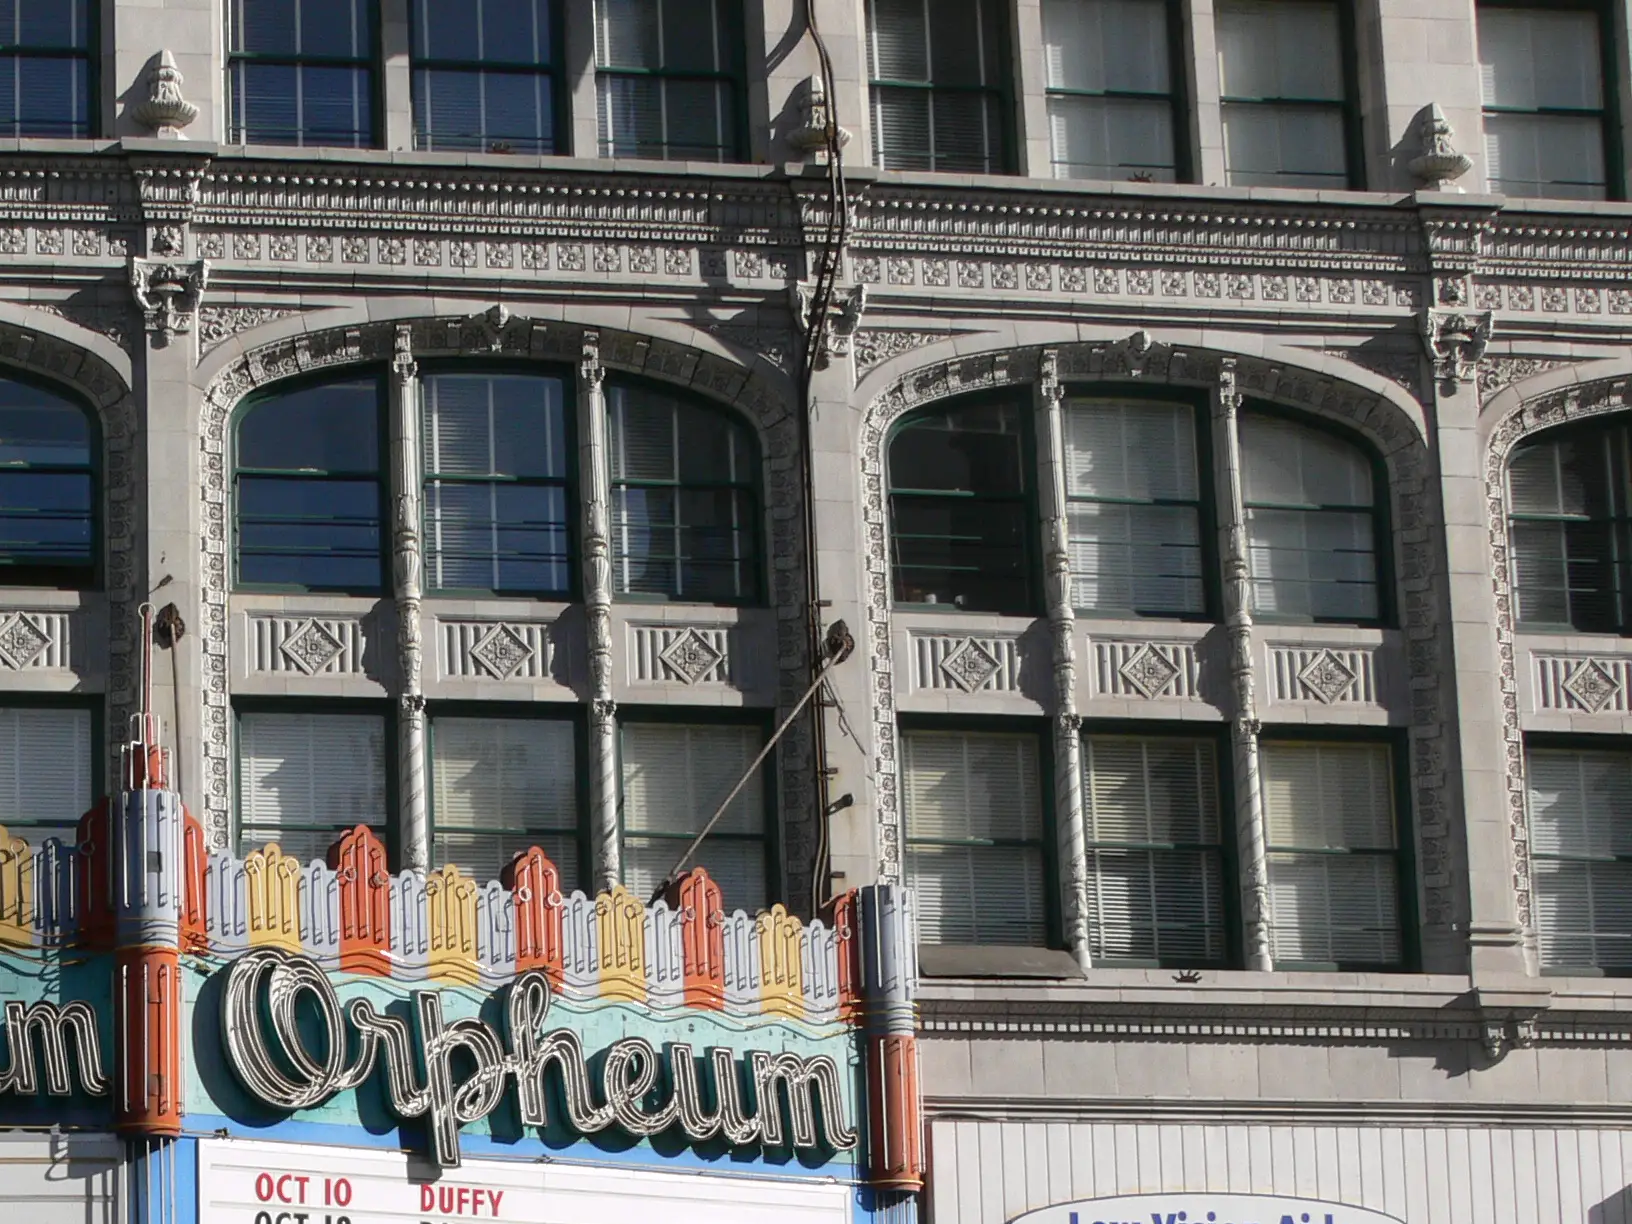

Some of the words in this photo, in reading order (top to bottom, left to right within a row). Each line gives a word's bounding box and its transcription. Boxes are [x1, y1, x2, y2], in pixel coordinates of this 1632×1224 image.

[222, 947, 858, 1168] Orpheum
[255, 1172, 310, 1204] OCT
[324, 1178, 353, 1207] 10
[420, 1183, 504, 1217] DUFFY
